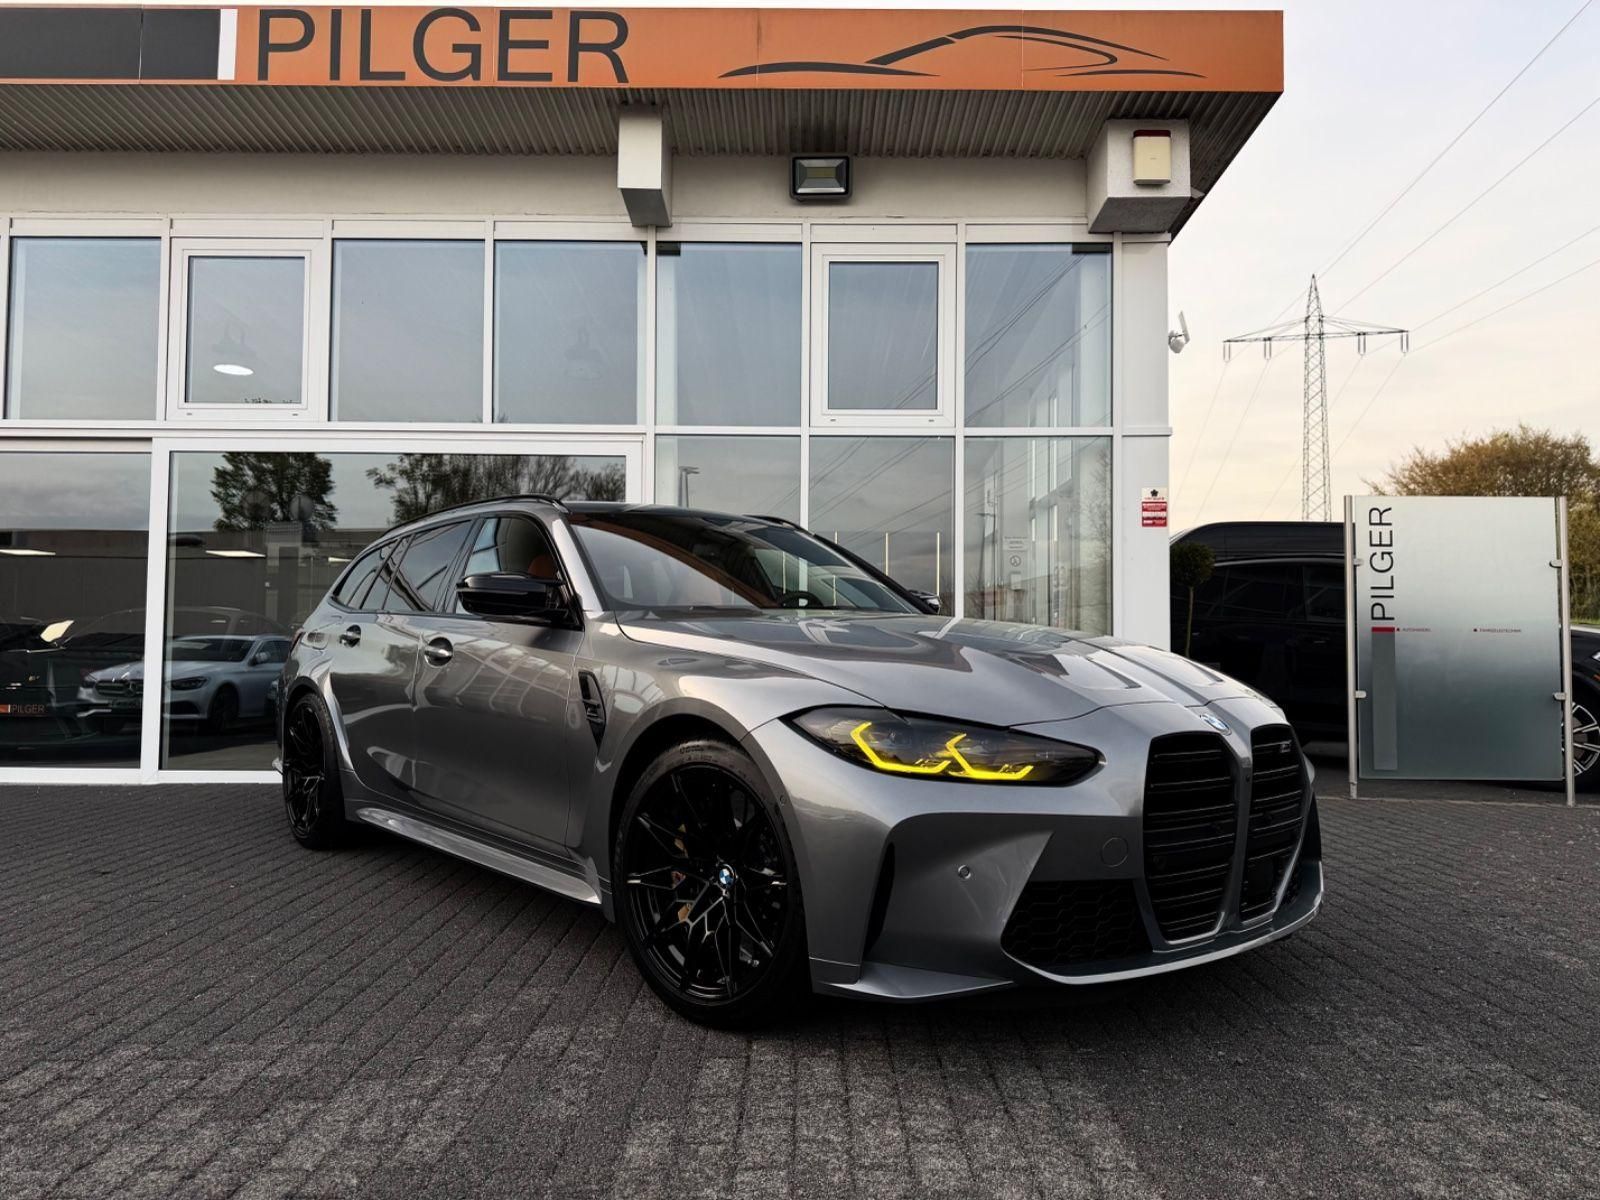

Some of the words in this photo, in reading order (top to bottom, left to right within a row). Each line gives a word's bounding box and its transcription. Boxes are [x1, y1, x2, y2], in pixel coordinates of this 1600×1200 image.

[257, 8, 630, 83] PILGER
[1368, 507, 1396, 621] PILGER
[11, 703, 45, 714] PILGER
